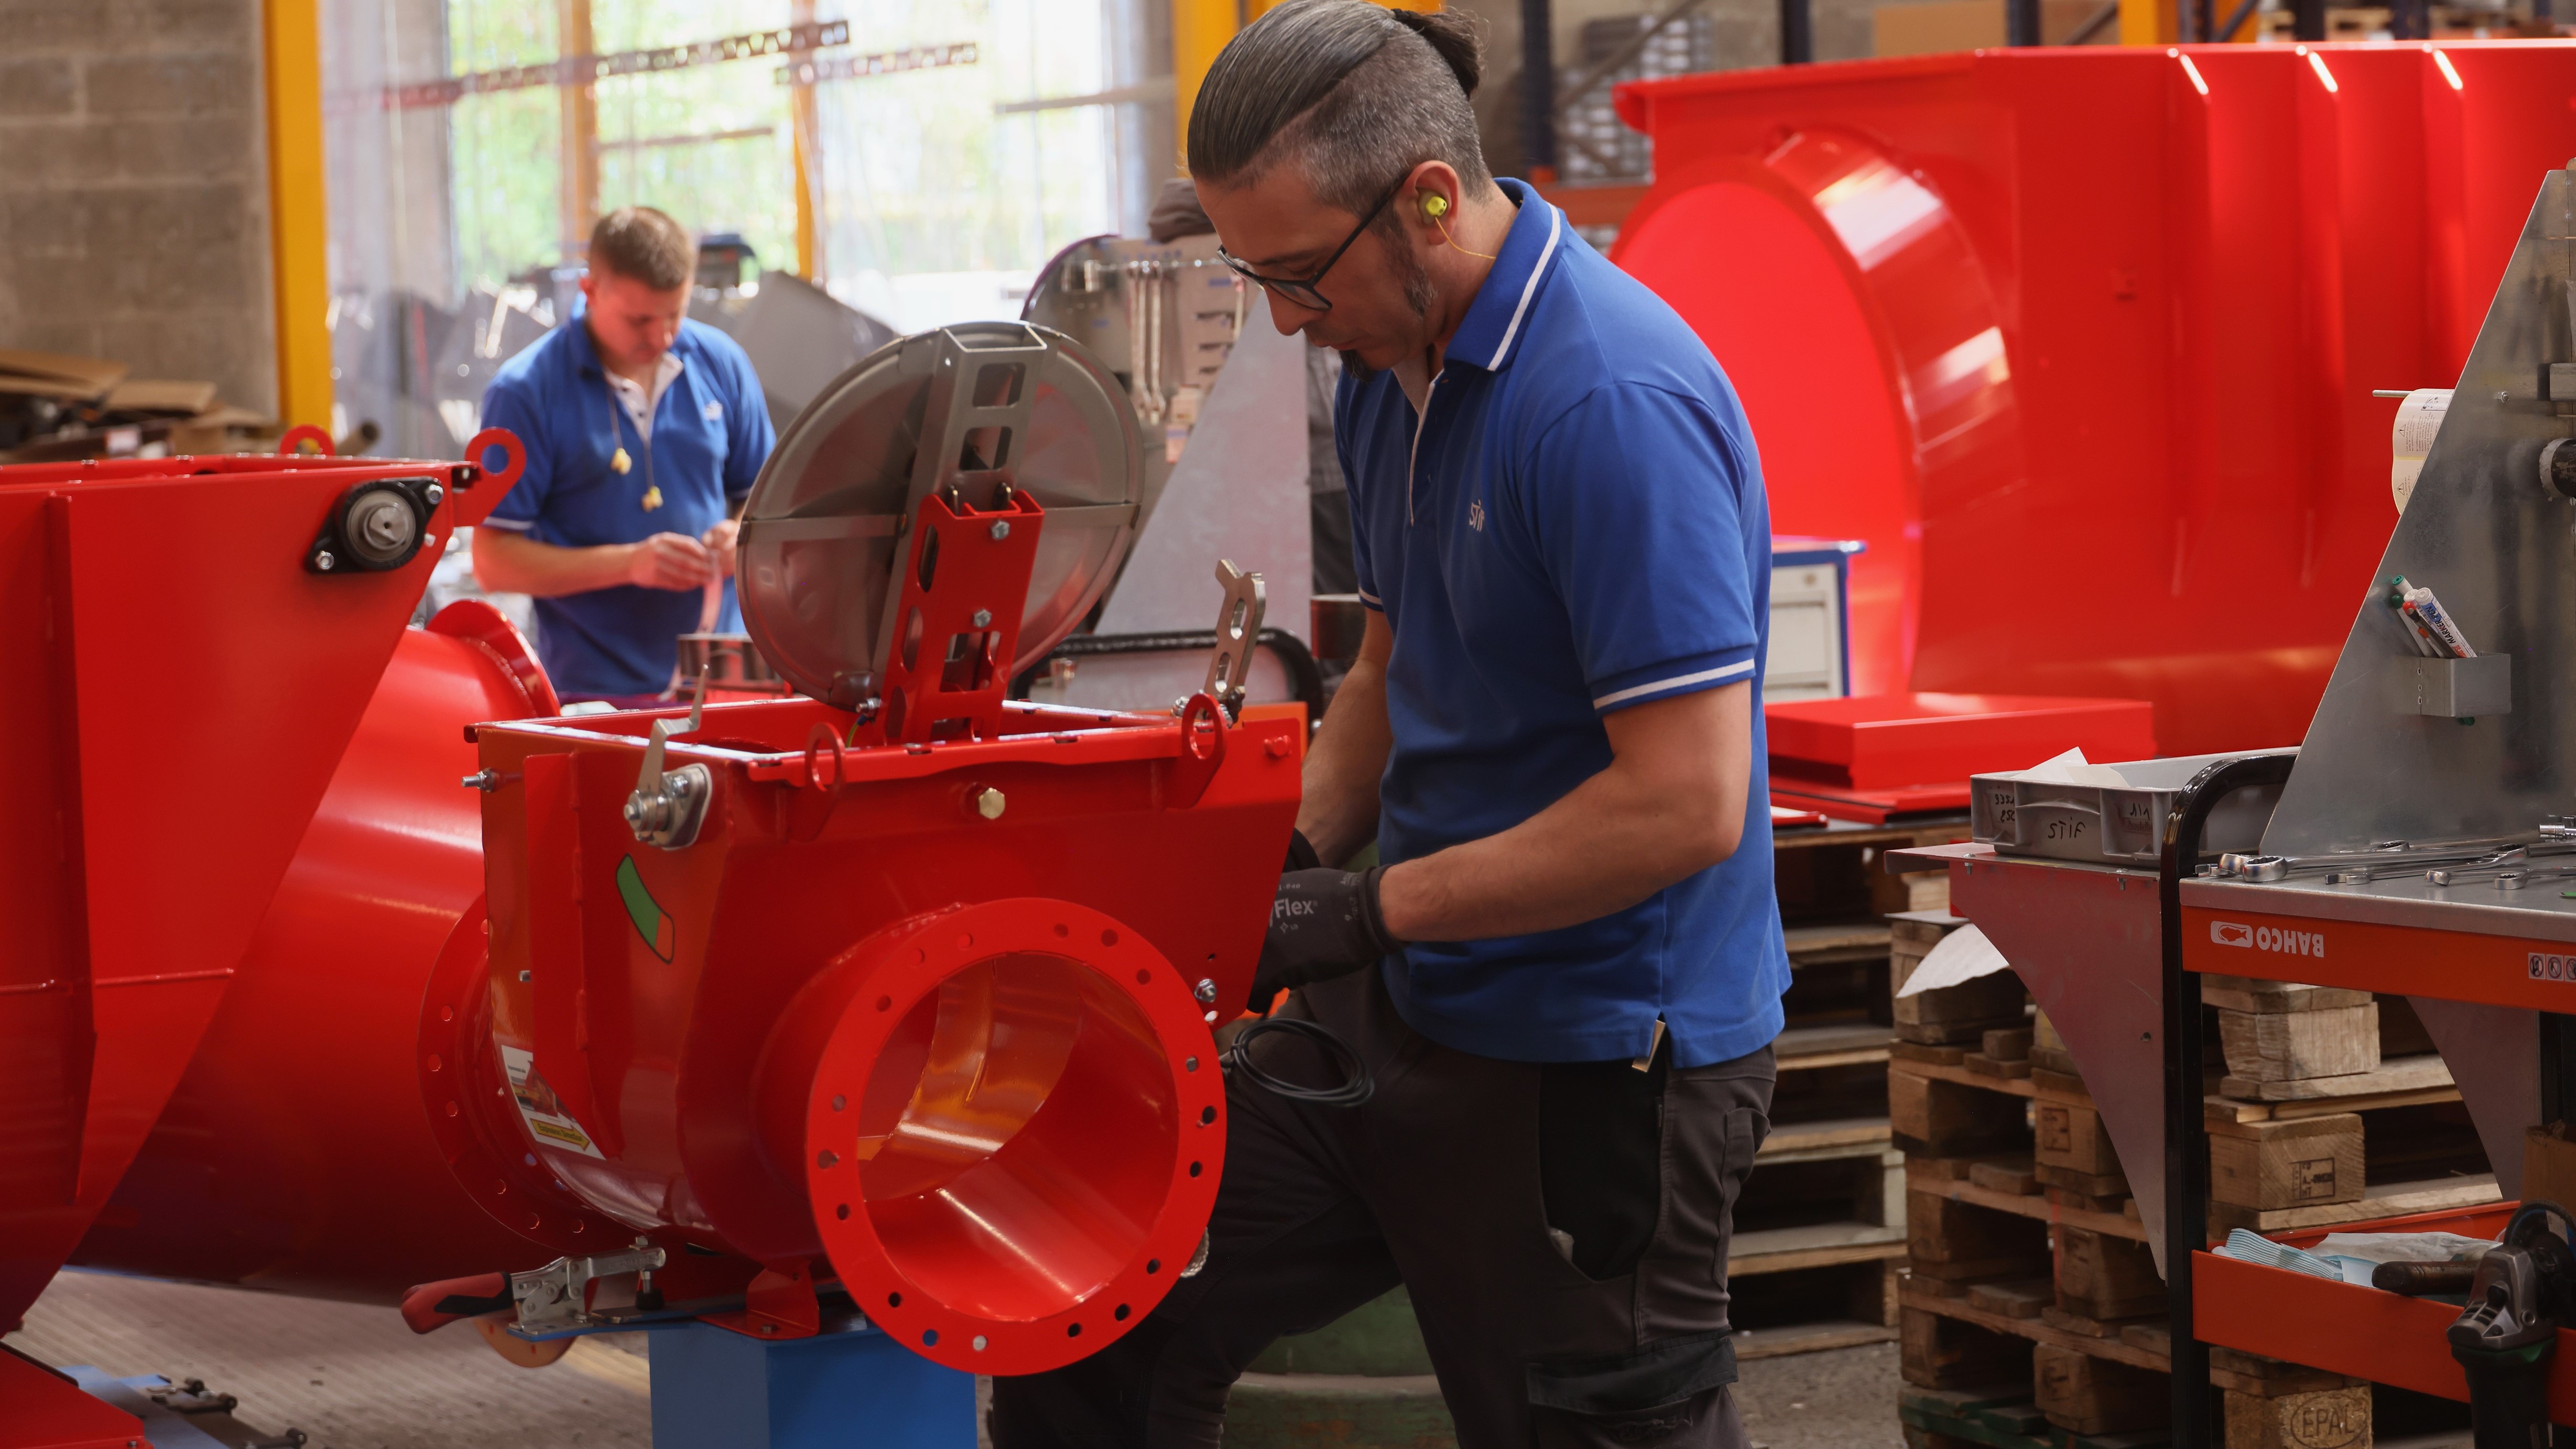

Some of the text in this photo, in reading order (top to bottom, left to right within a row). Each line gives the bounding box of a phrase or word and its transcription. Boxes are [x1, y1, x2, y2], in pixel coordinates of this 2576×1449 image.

[2426, 606, 2457, 644] MARKER PEN
[1269, 898, 1314, 927] Flex
[2256, 926, 2324, 958] BAHCO
[2302, 1404, 2355, 1438] EPAL
